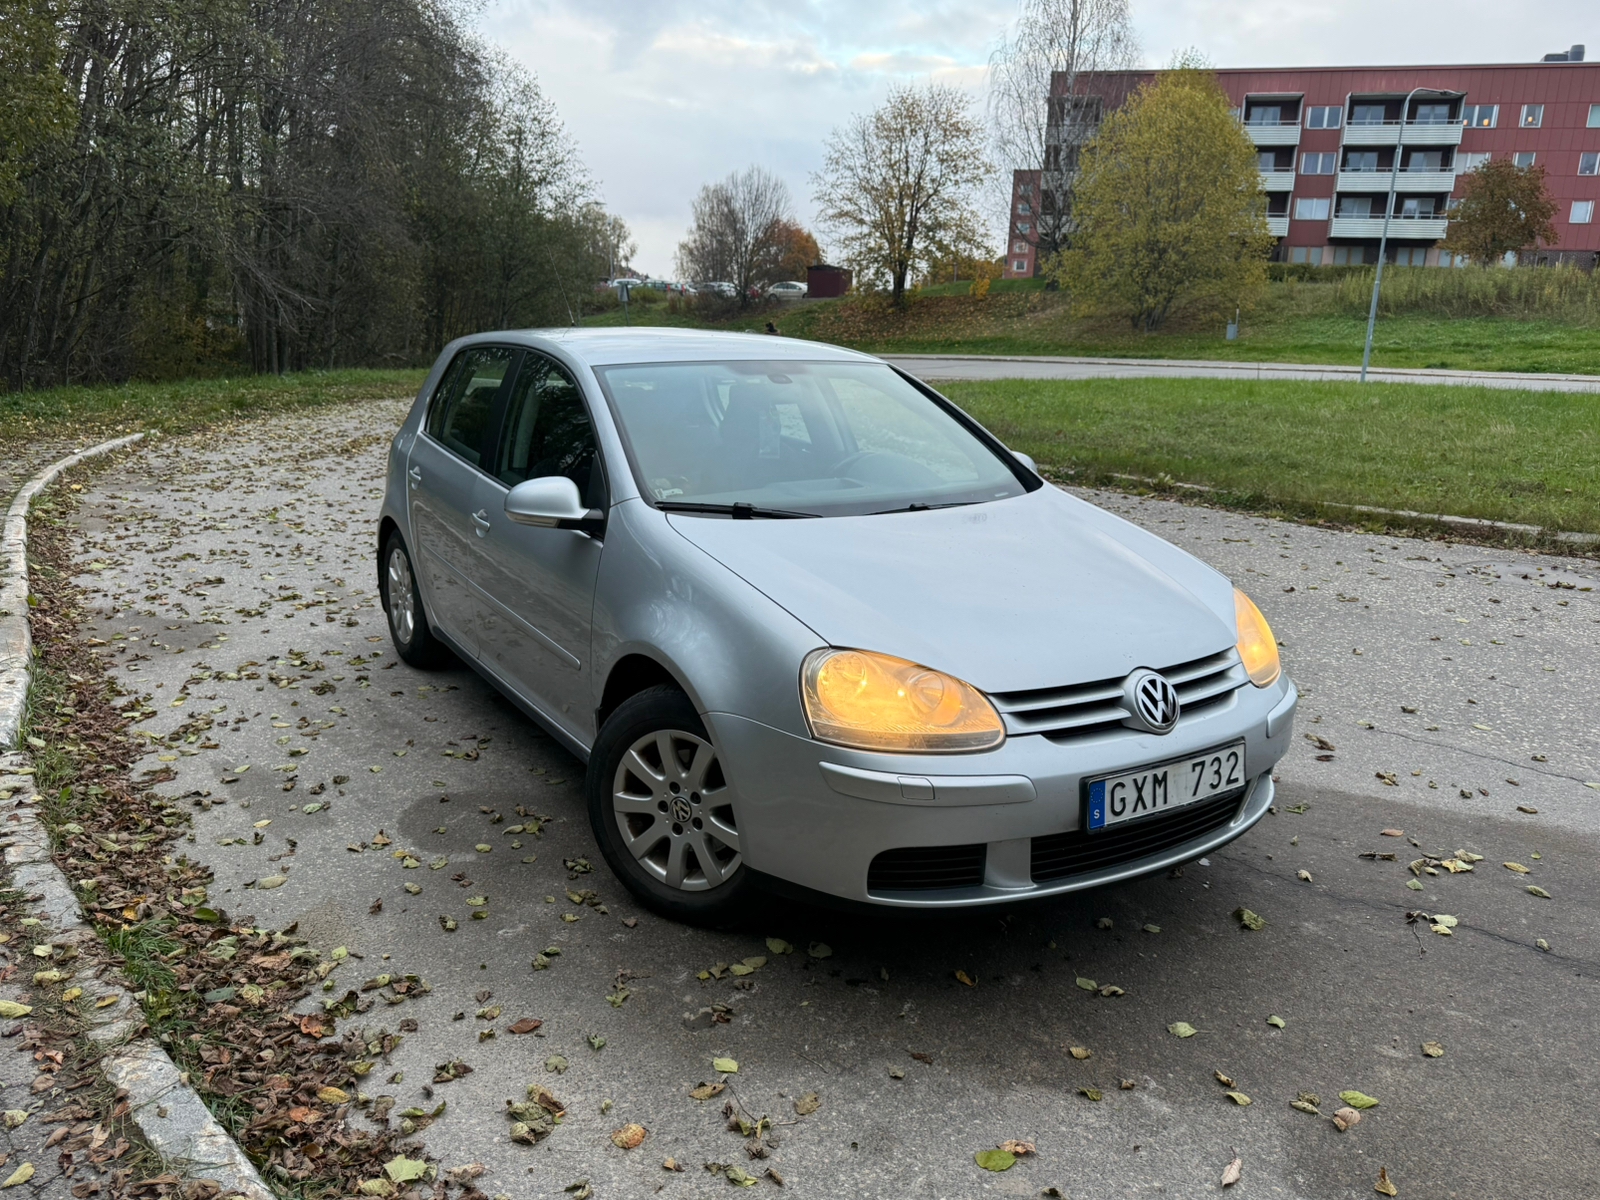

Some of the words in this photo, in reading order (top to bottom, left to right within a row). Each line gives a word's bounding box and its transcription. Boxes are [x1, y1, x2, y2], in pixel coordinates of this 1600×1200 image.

[1138, 677, 1178, 725] VW
[1110, 770, 1168, 816] GXM
[1192, 751, 1239, 796] 732
[1093, 809, 1100, 819] S
